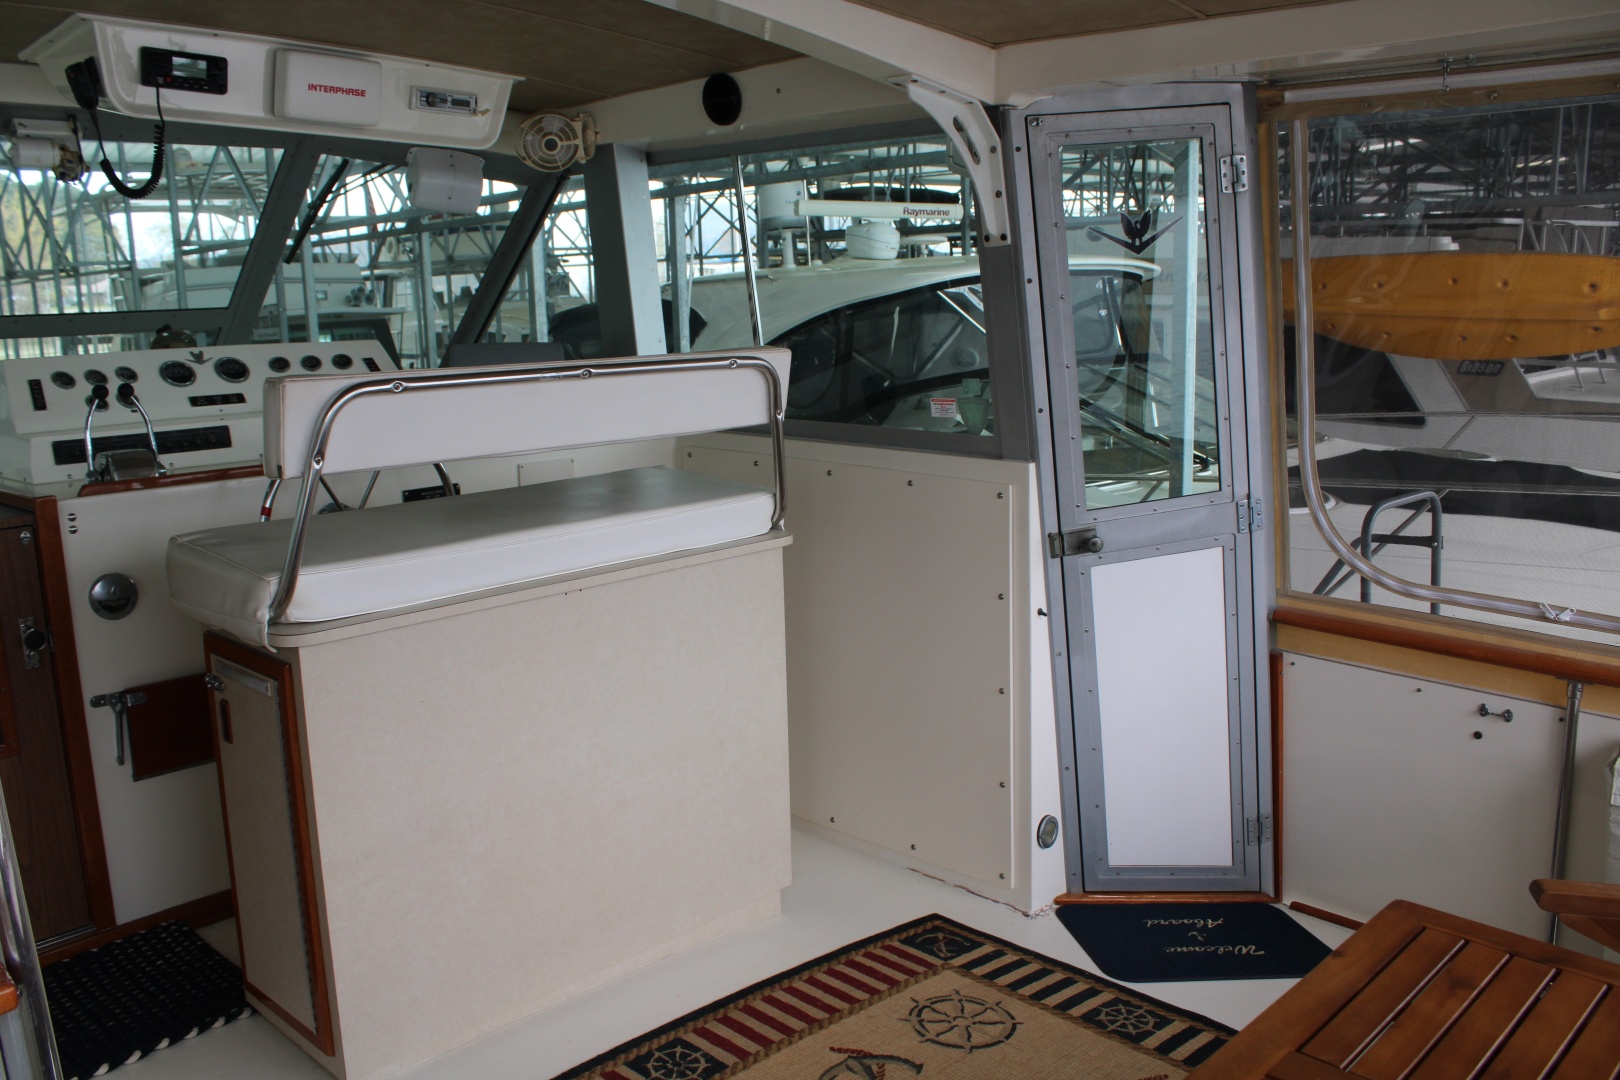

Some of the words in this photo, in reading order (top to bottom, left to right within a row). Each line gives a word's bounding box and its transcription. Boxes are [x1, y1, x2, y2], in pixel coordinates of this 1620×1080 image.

[307, 83, 366, 97] INTERPHASE
[903, 207, 950, 216] Raymarine
[1143, 918, 1224, 928] Aboard
[1165, 945, 1265, 955] Welcome
